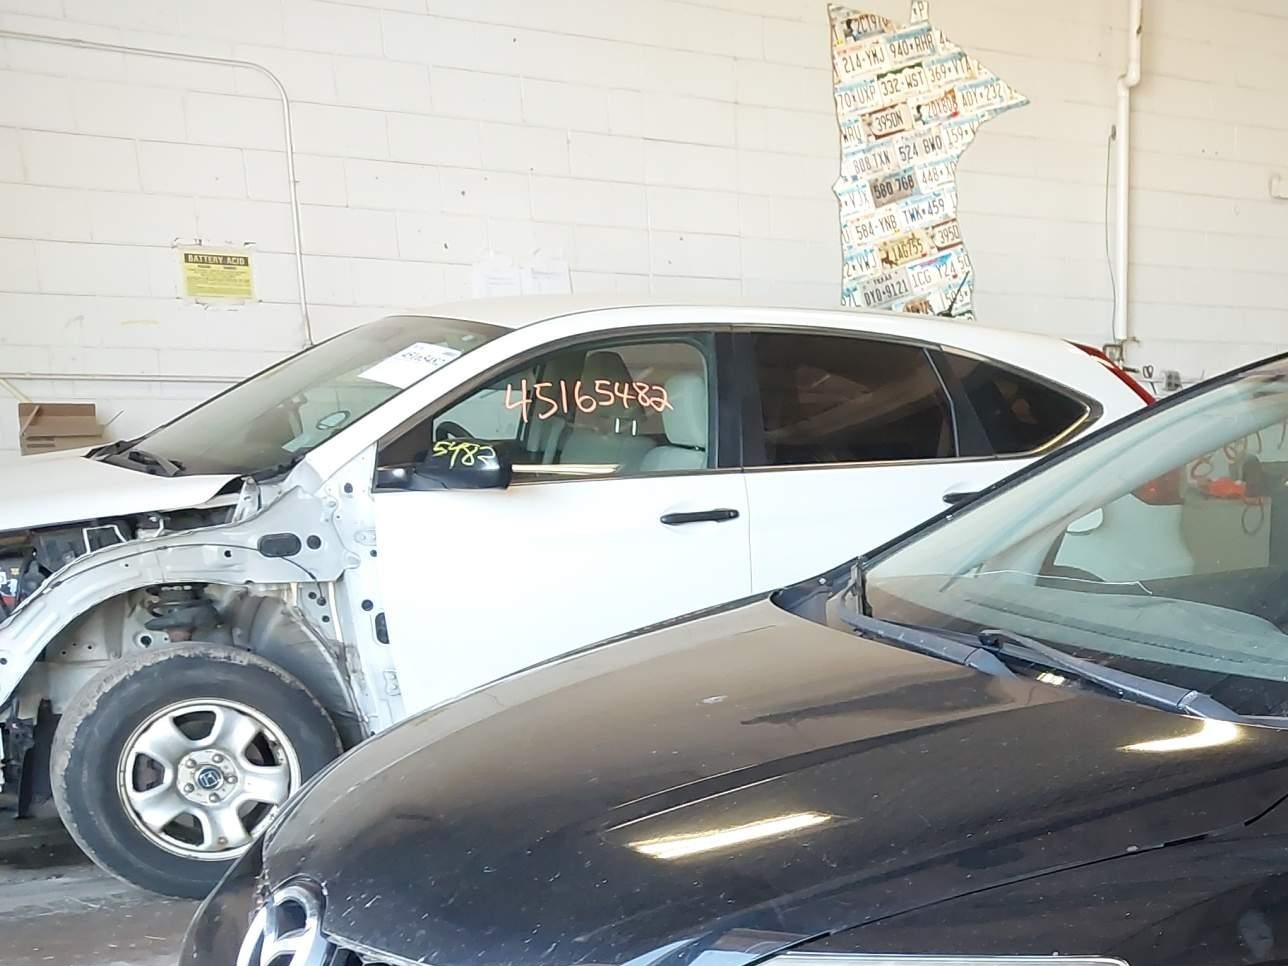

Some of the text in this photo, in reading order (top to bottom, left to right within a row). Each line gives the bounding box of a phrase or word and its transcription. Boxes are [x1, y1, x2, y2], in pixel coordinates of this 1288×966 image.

[188, 255, 245, 265] BATTERY ACID
[505, 379, 673, 423] 45165482
